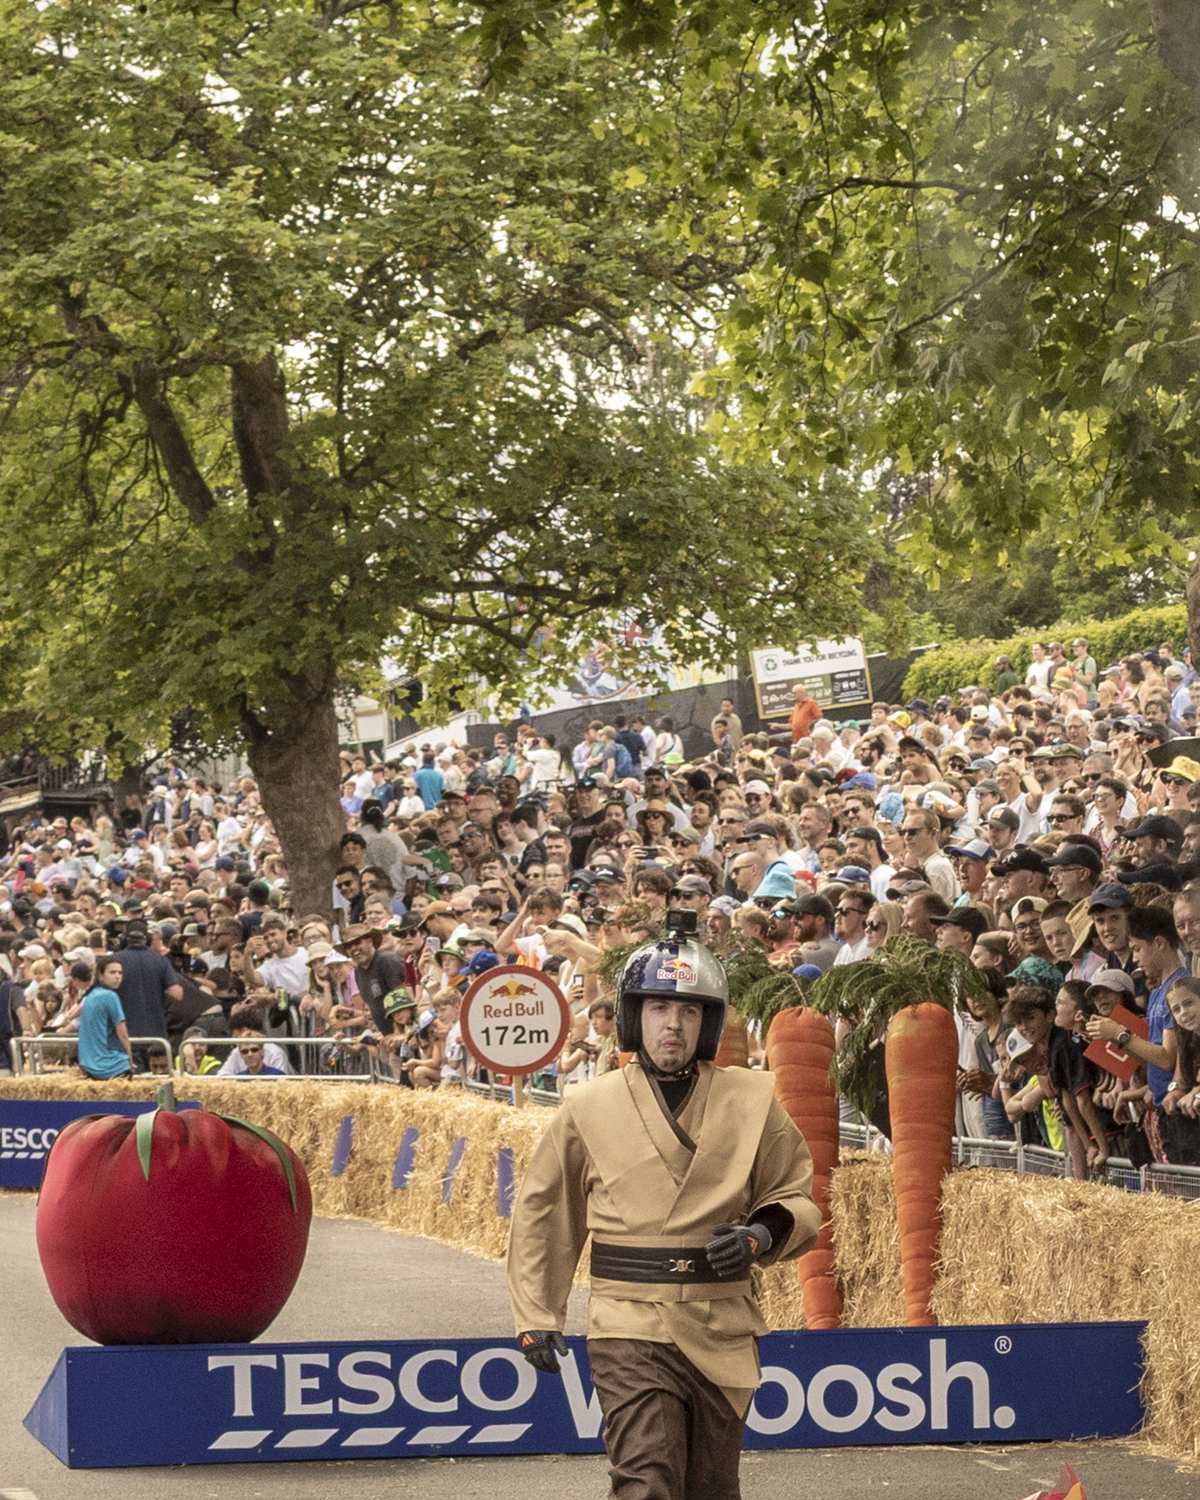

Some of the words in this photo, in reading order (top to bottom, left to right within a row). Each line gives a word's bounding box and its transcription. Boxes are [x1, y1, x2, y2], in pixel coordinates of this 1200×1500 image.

[657, 970, 677, 980] Red
[678, 970, 697, 983] Bull
[483, 1002, 513, 1019] Red
[515, 1001, 544, 1016] Bull
[481, 1025, 549, 1046] 172m
[0, 1127, 59, 1150] ESCO
[207, 1348, 538, 1417] TESCO
